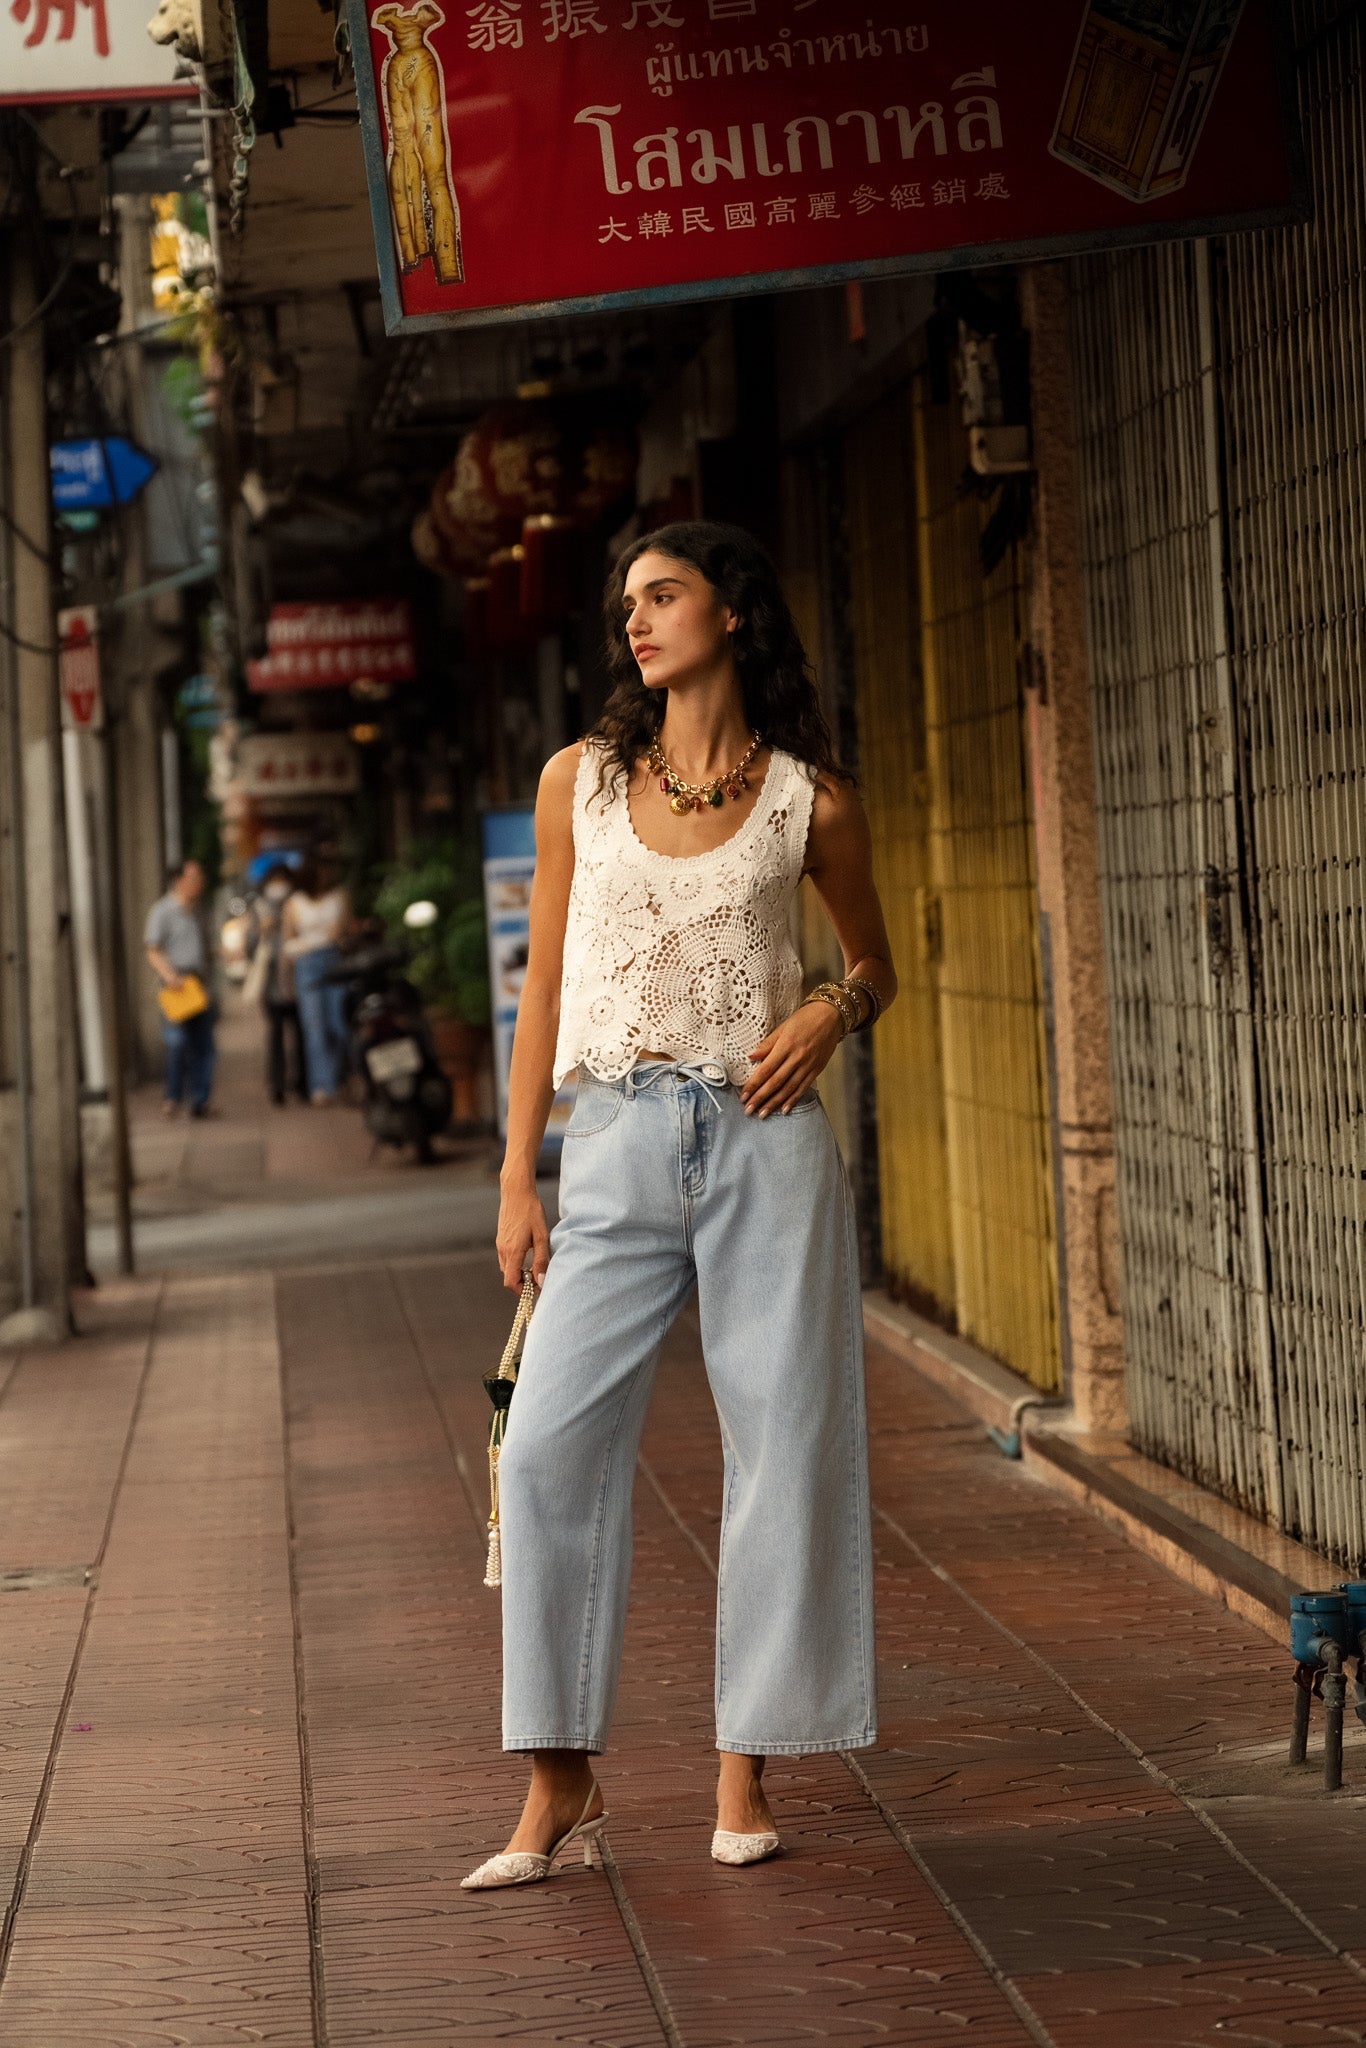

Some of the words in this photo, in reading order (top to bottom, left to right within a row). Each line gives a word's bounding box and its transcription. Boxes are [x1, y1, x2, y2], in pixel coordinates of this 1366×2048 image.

[645, 19, 930, 97] ผู้แทนจำหน่าย
[573, 65, 1004, 195] โสมเกาหลี
[598, 172, 1011, 244] 大韓民國高麗參經銷處
